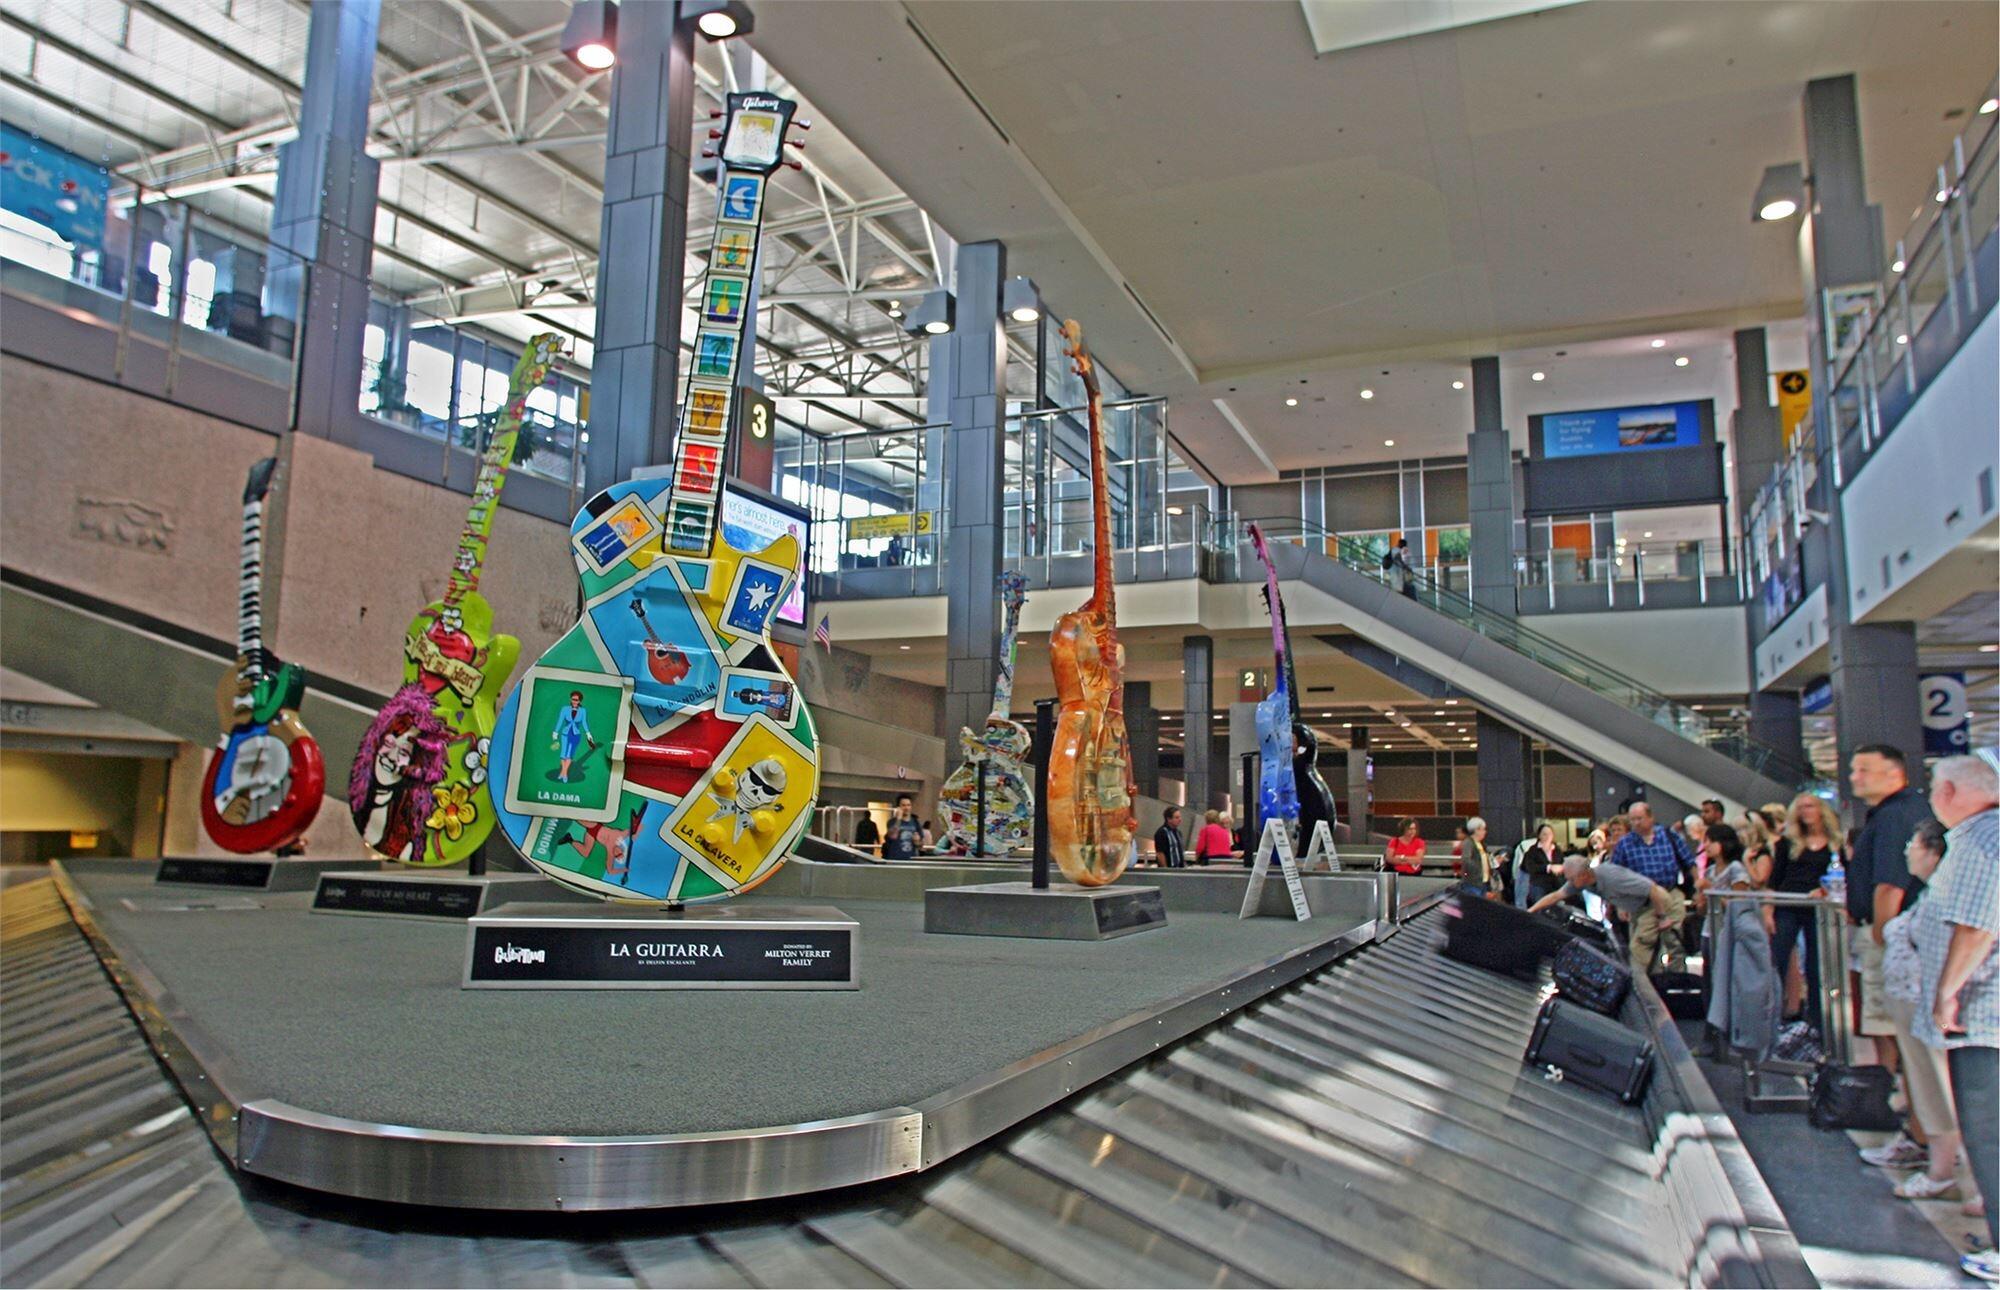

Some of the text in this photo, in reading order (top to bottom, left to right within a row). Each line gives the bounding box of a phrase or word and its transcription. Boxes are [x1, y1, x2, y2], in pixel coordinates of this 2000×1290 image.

[752, 403, 767, 438] 3
[1244, 671, 1255, 687] 2
[1928, 688, 1953, 717] 2
[537, 790, 580, 803] LA DAMA
[680, 824, 743, 874] LA CALAVERA
[610, 943, 725, 958] LA GUITARRA
[764, 950, 832, 958] MILTON VERRET
